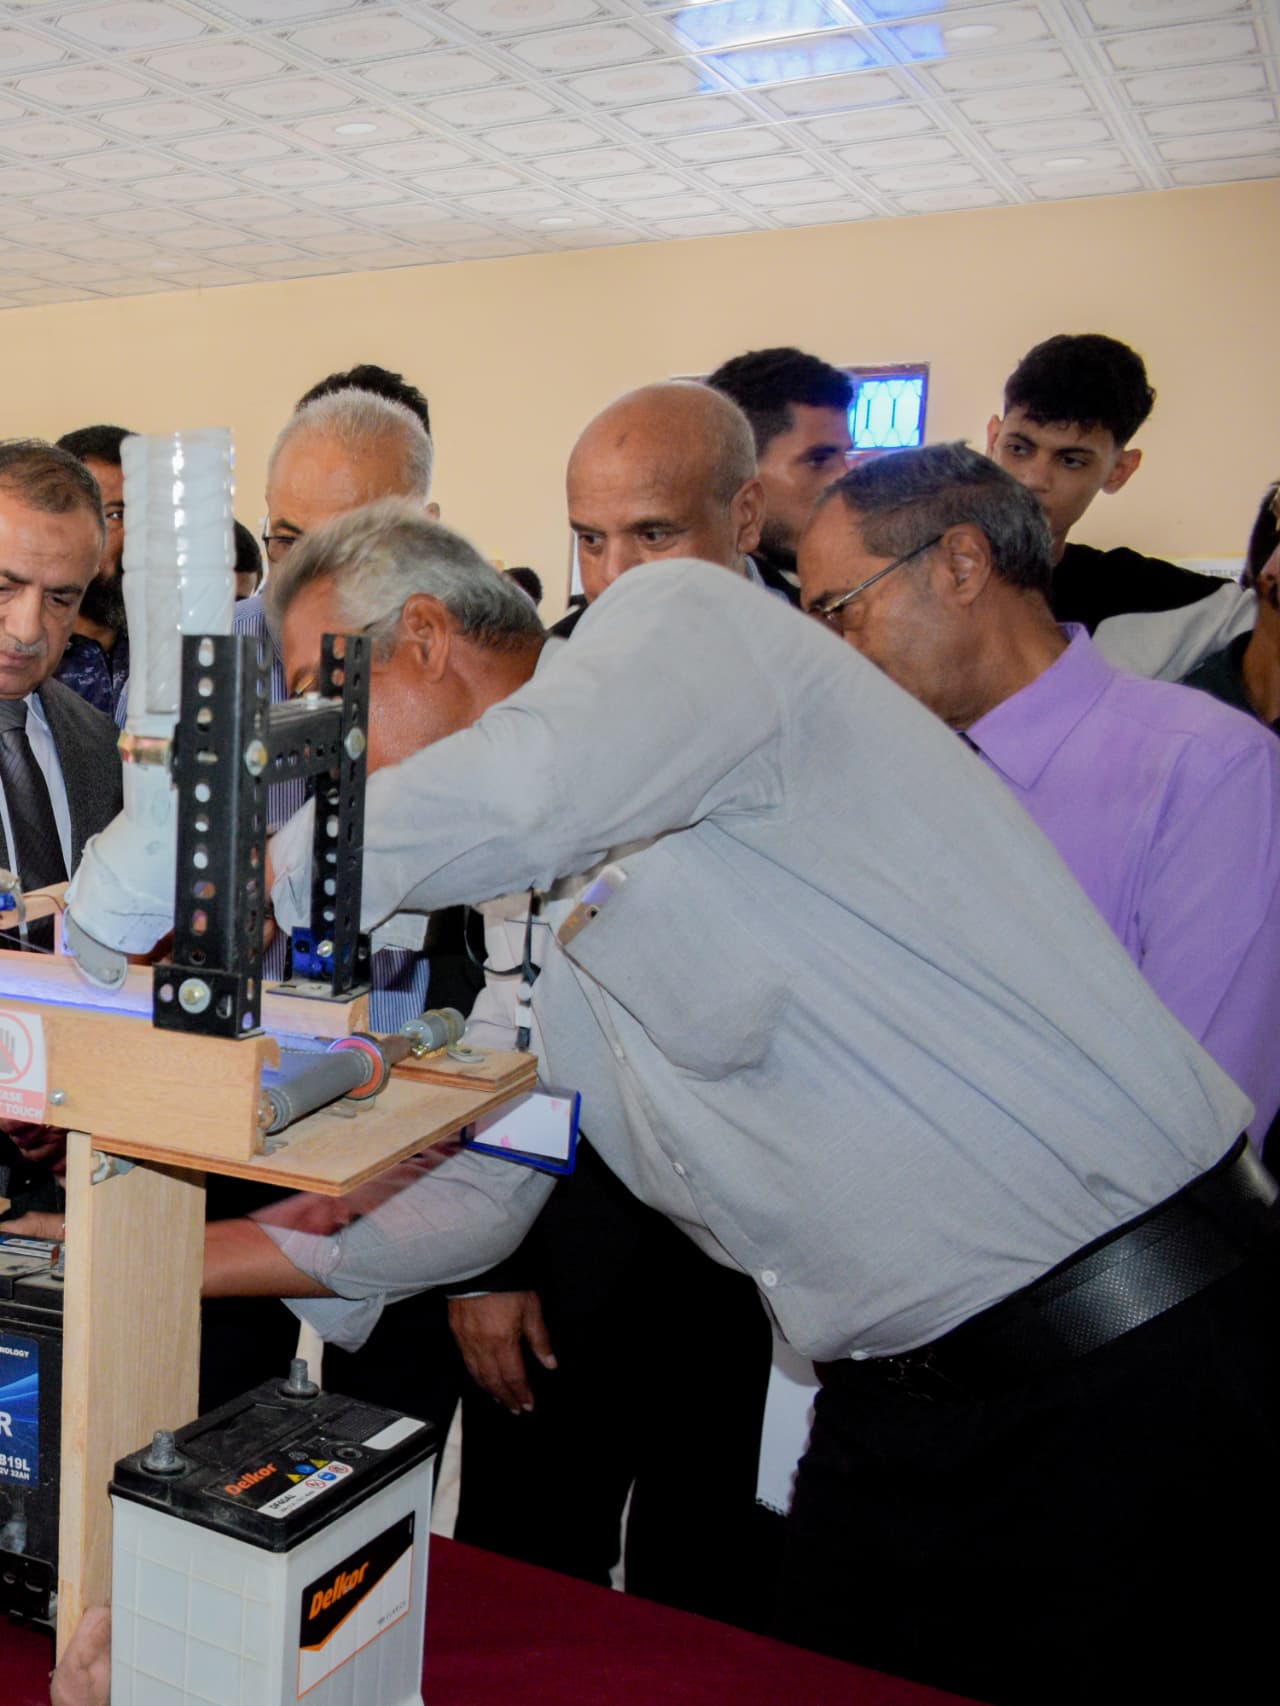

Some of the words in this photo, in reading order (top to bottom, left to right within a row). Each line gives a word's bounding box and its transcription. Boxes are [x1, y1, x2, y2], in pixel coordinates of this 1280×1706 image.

[6, 1103, 43, 1119] TOUCH
[224, 1462, 277, 1497] Delkor
[308, 1561, 369, 1621] Delkor
